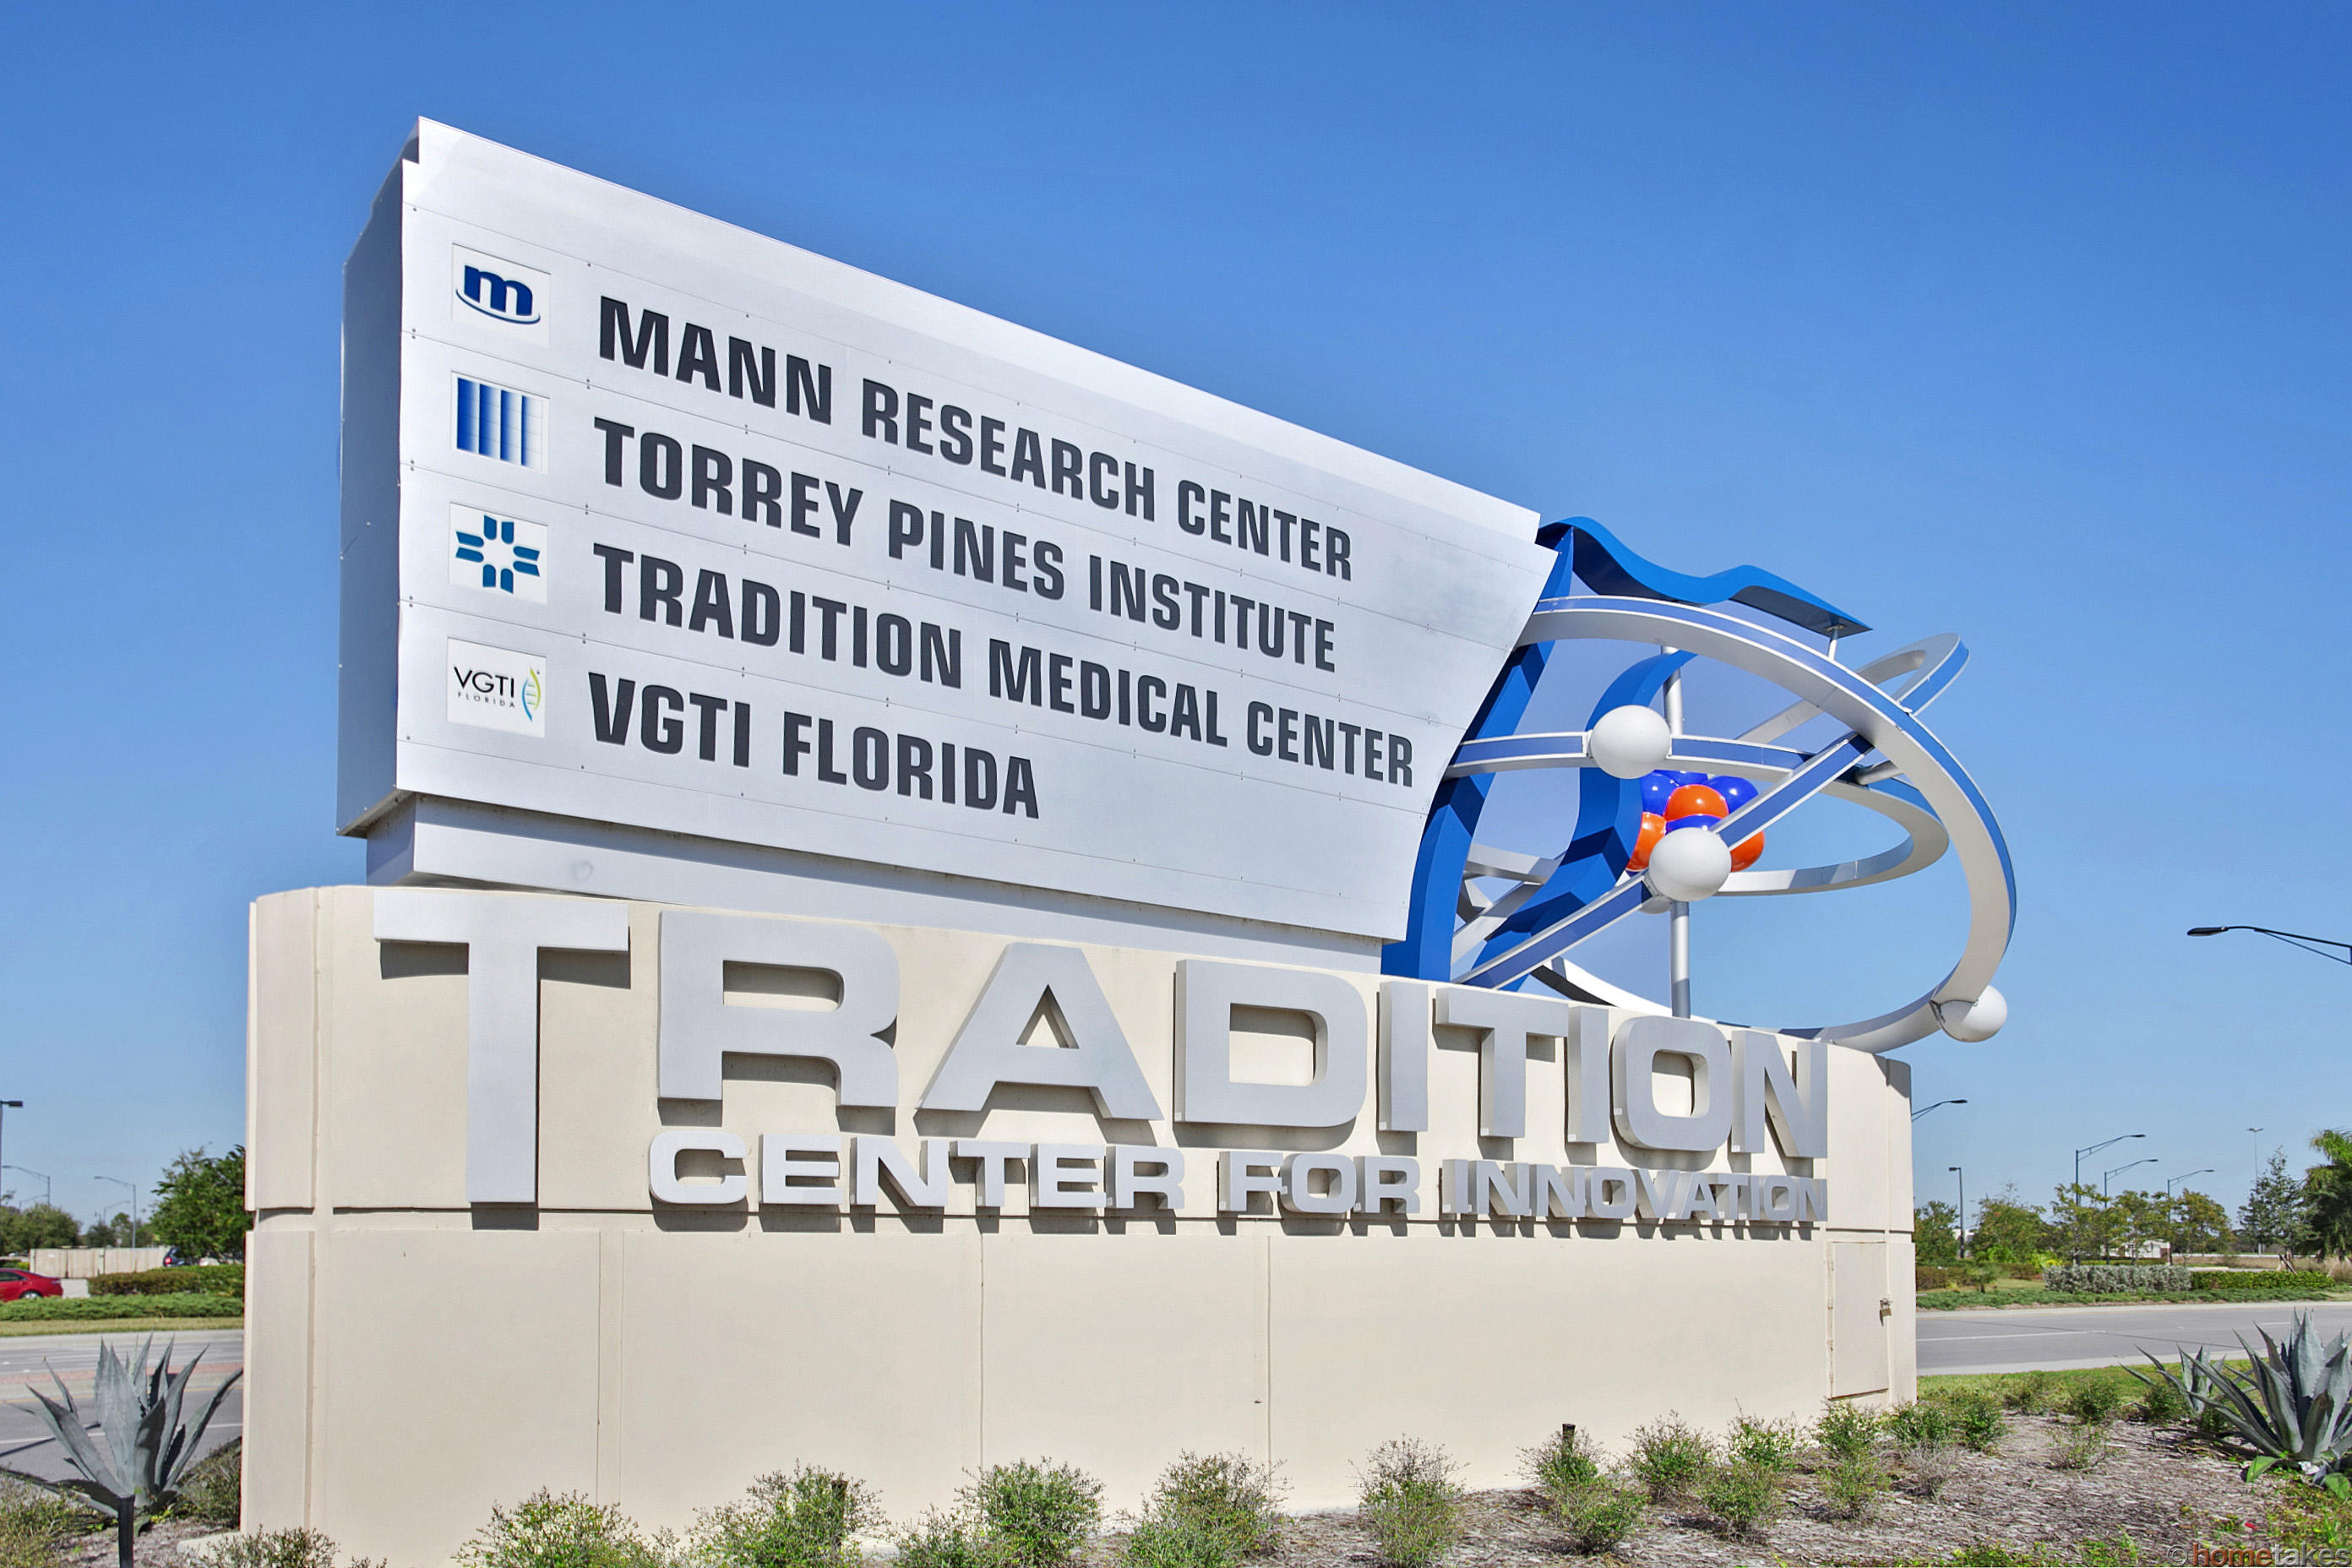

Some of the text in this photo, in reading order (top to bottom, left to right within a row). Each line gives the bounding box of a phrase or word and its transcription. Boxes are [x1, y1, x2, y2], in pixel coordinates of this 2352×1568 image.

[599, 295, 1352, 582] MANN RESEARCH CENTER
[594, 416, 1335, 673] TORREY PINES INSTITUTE
[454, 666, 514, 698] VGTI
[458, 691, 514, 709] FLORIDA
[587, 672, 1039, 819] VGTI FLORIDA
[593, 542, 1413, 787] TRADITION MEDICAL CENTER
[373, 888, 1827, 1205] TRADITION
[649, 1130, 1827, 1222] CENTER FOR INNOVATION
